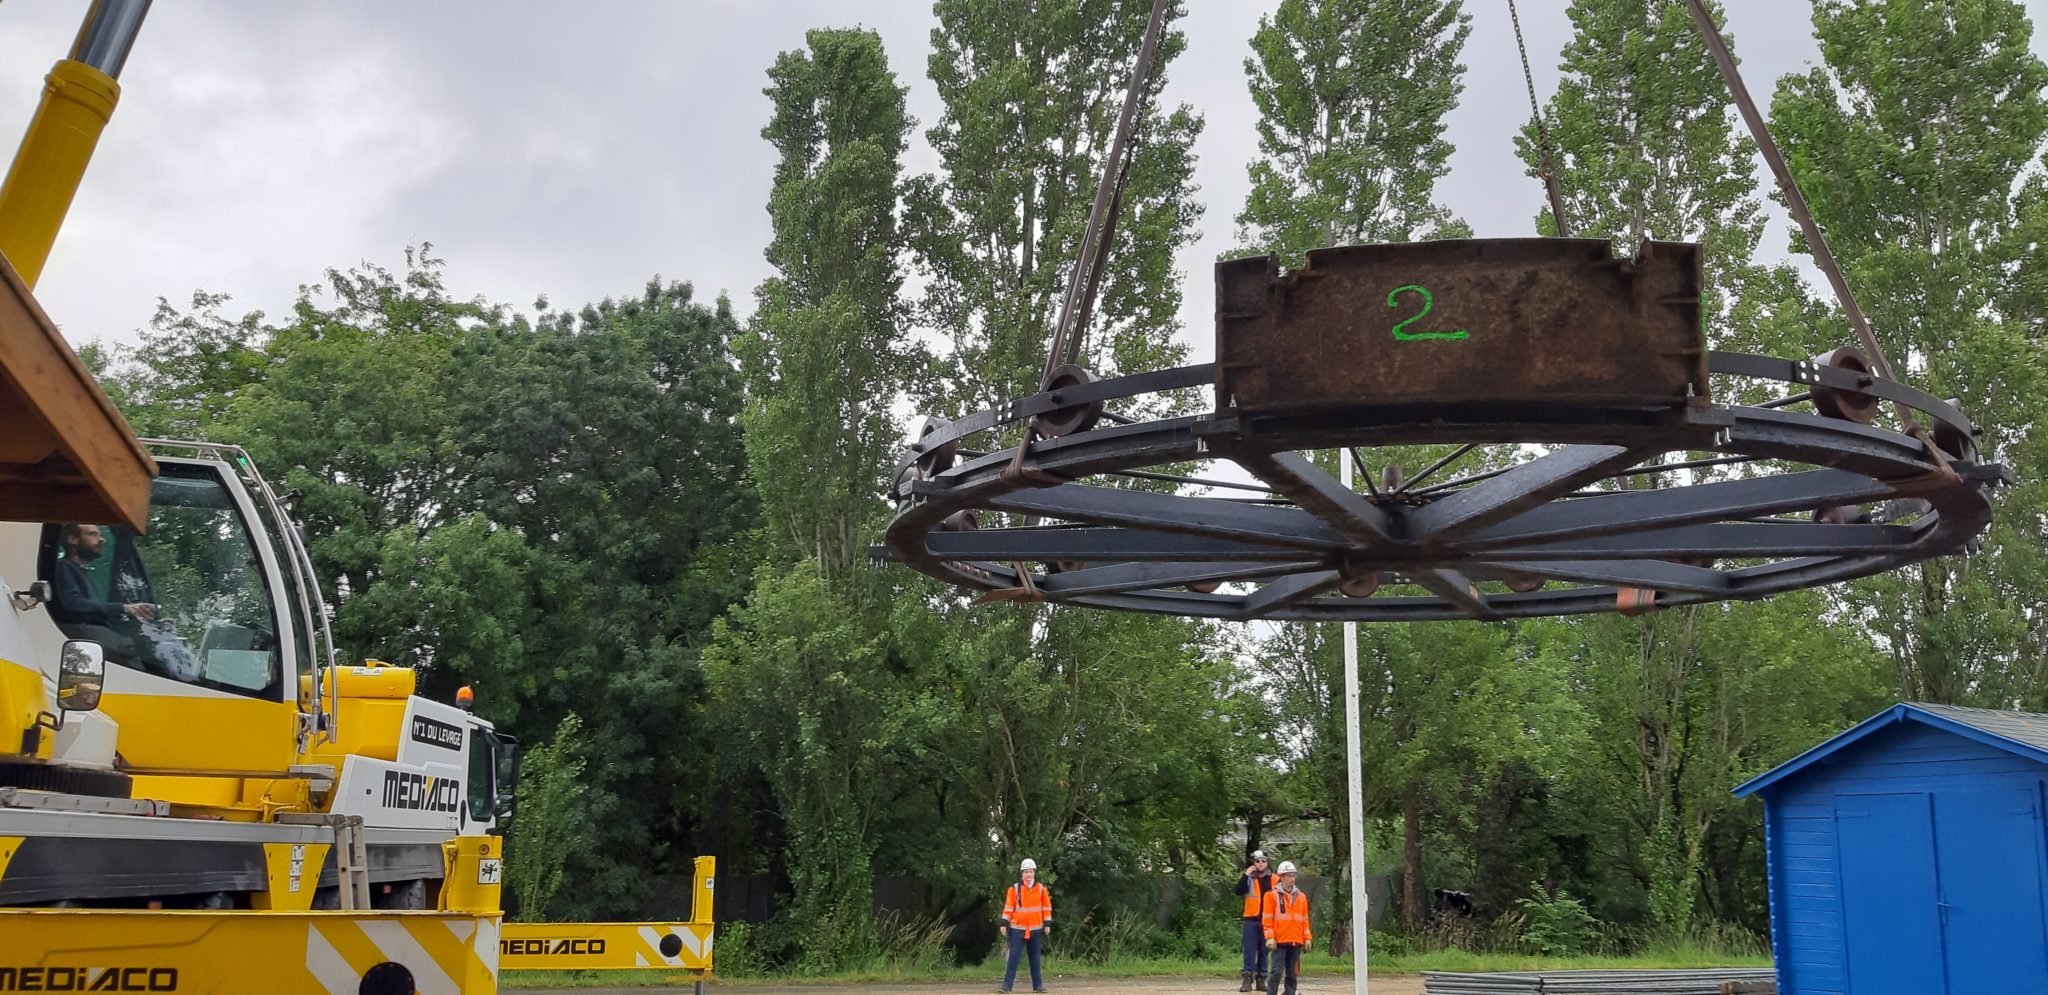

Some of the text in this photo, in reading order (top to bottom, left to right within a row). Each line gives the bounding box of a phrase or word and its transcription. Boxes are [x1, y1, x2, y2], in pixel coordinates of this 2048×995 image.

[1387, 284, 1470, 341] 2
[427, 725, 437, 739] DU
[438, 727, 461, 746] LEVAGE
